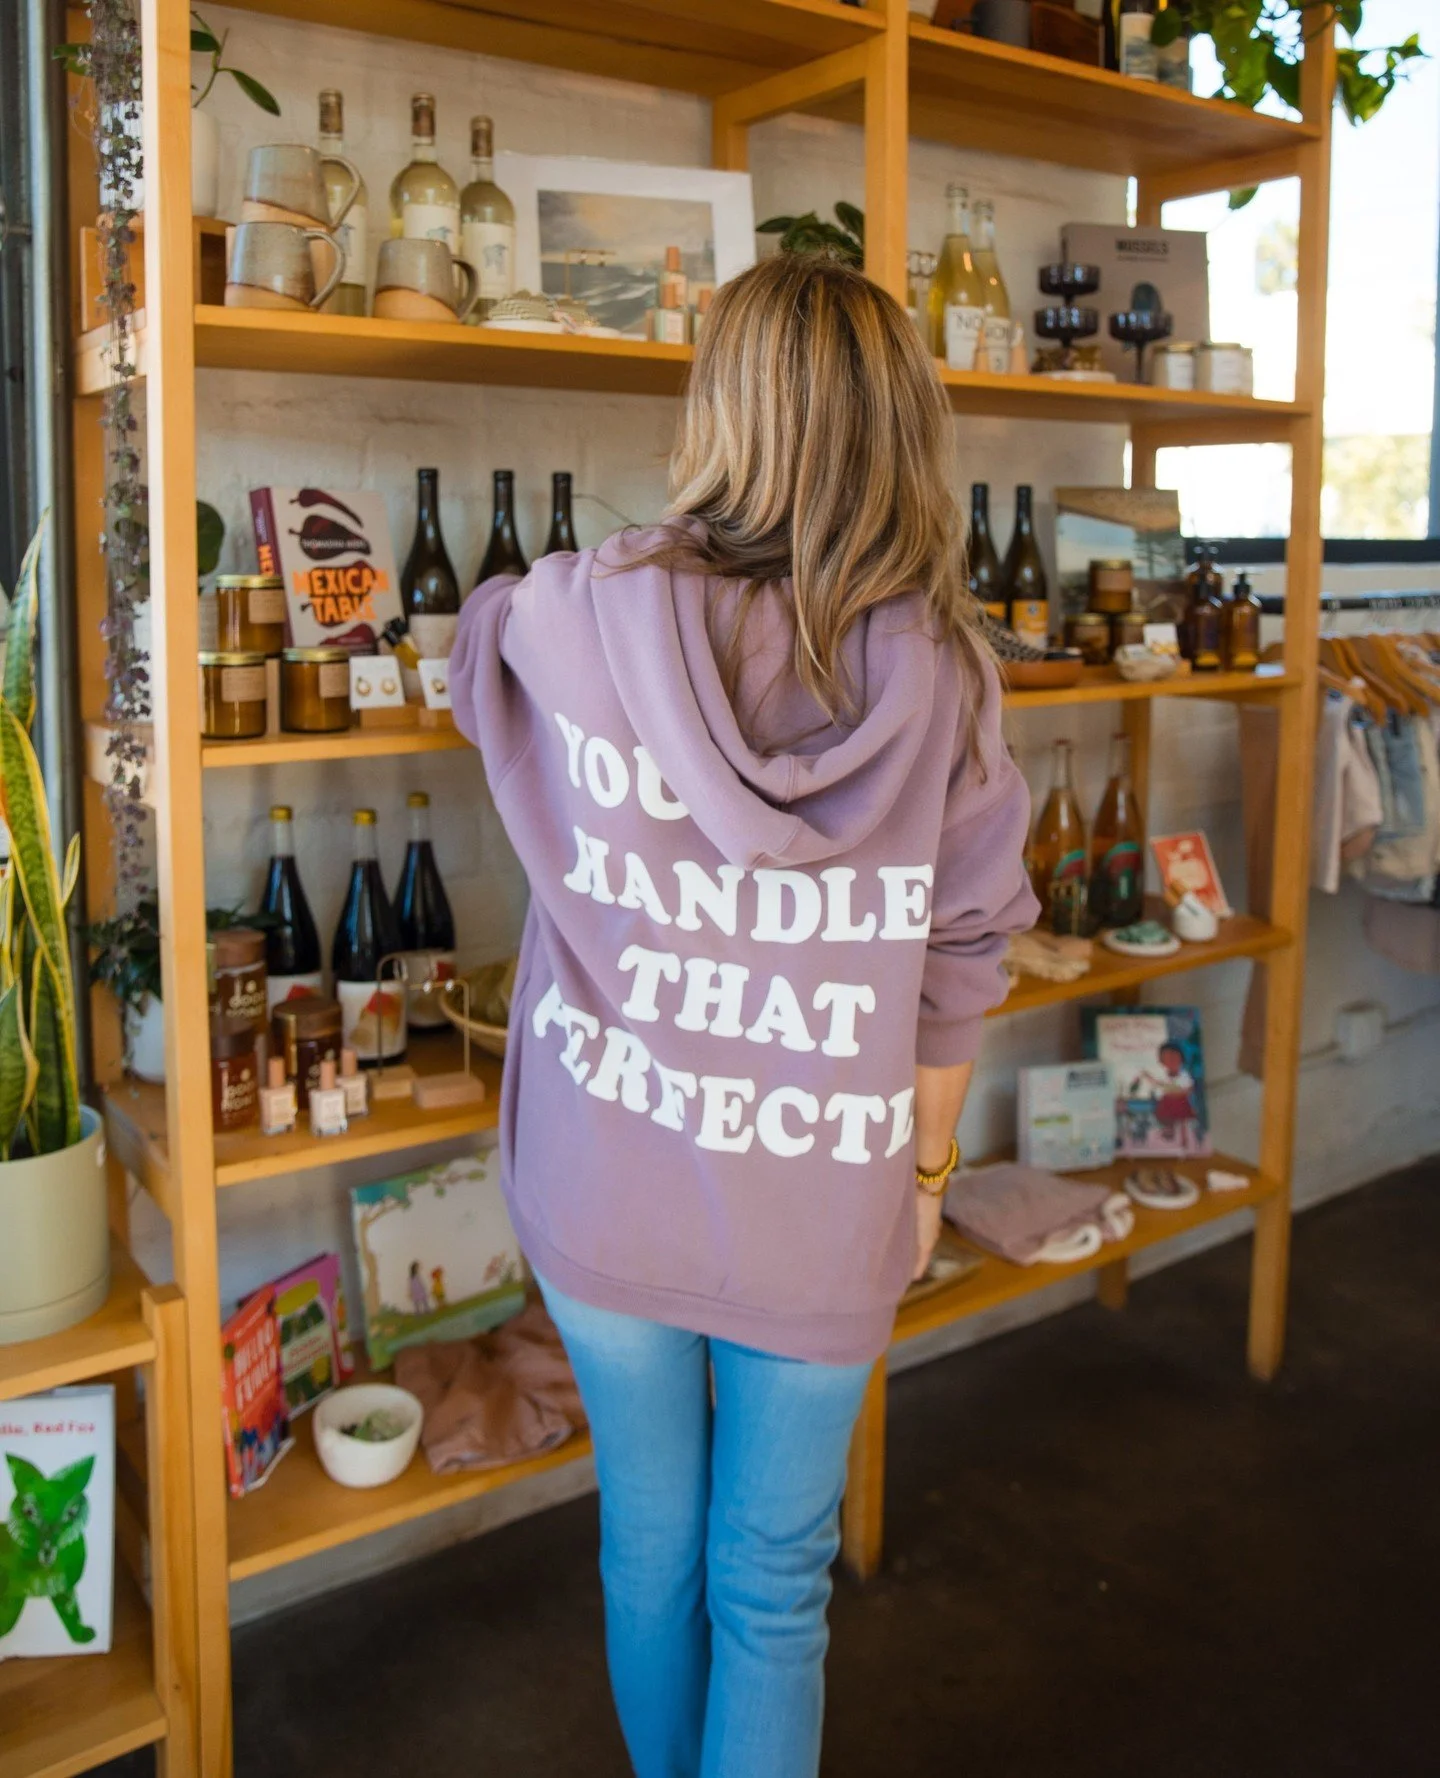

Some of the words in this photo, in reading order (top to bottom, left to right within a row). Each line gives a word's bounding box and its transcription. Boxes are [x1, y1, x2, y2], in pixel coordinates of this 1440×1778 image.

[292, 566, 389, 597] MEXICAN
[310, 594, 377, 624] TABLE
[554, 712, 690, 821] YOU
[563, 826, 933, 945] HANDLE
[617, 944, 876, 1058] THAT
